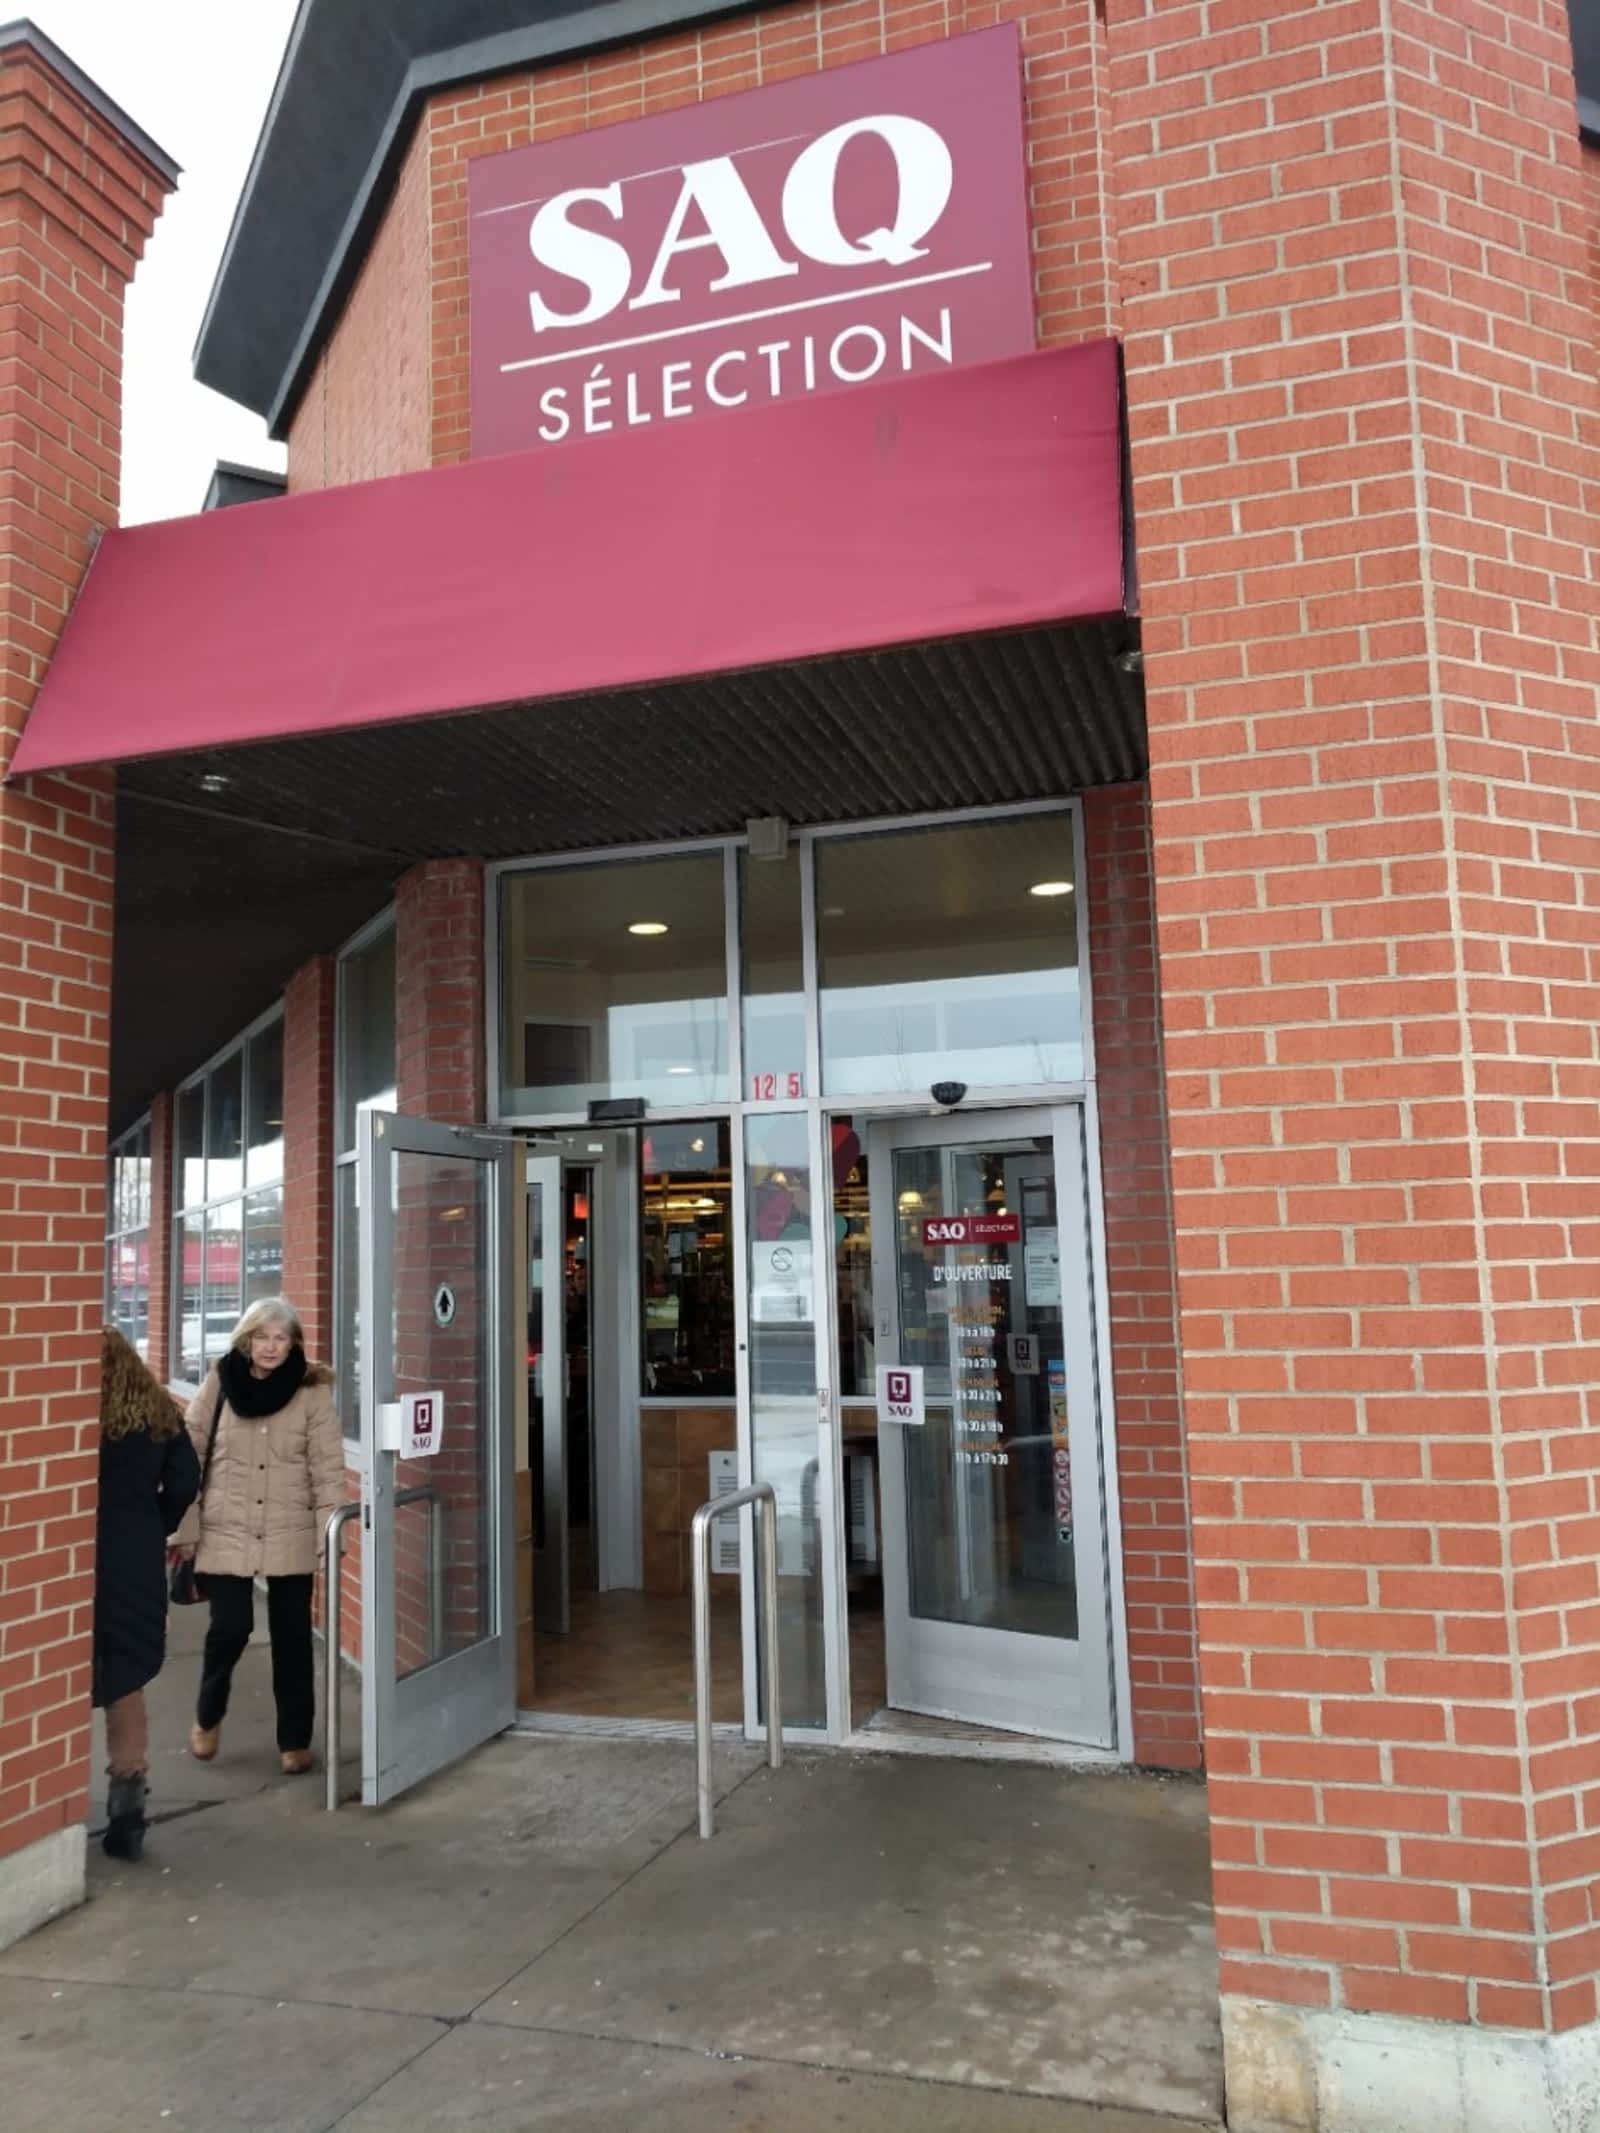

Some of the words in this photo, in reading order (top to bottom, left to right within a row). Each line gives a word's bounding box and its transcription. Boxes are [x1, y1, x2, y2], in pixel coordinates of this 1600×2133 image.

[529, 113, 953, 333] SAQ
[538, 308, 953, 441] SÉLECTION
[927, 1222, 965, 1241] SAQ
[933, 1264, 1013, 1282] D'OUVERTURE
[888, 1405, 913, 1417] SAQ
[411, 1436, 432, 1449] SAQ
